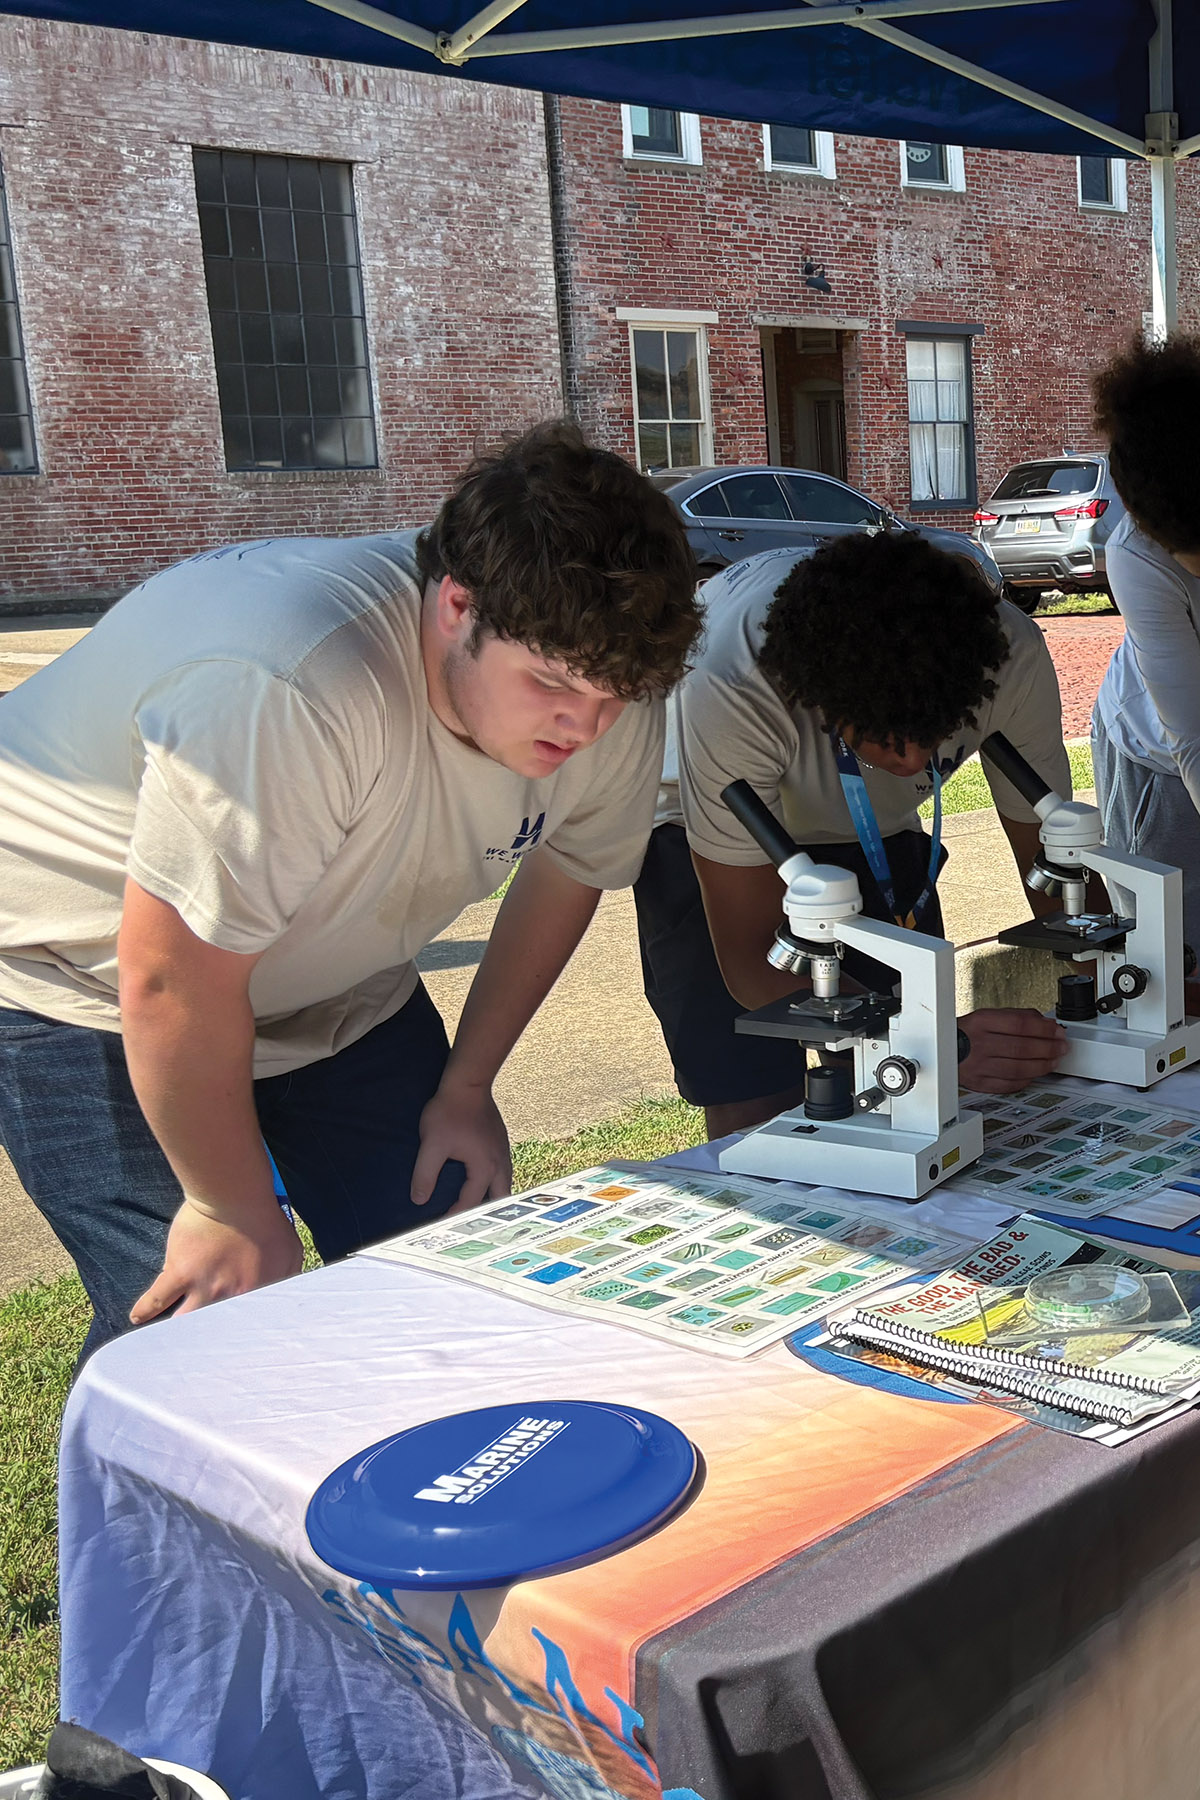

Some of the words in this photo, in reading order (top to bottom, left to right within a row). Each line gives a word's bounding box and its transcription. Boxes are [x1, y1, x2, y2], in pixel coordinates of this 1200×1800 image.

[874, 1301, 914, 1317] THE
[907, 1282, 960, 1309] GOOD,
[948, 1261, 987, 1283] THE
[978, 1239, 1015, 1264] BAD
[1008, 1230, 1030, 1242] &
[915, 1299, 951, 1316] THE
[947, 1254, 1026, 1302] MANAGED:
[413, 1417, 550, 1503] MARINE
[454, 1420, 565, 1504] SOLUTIONS
